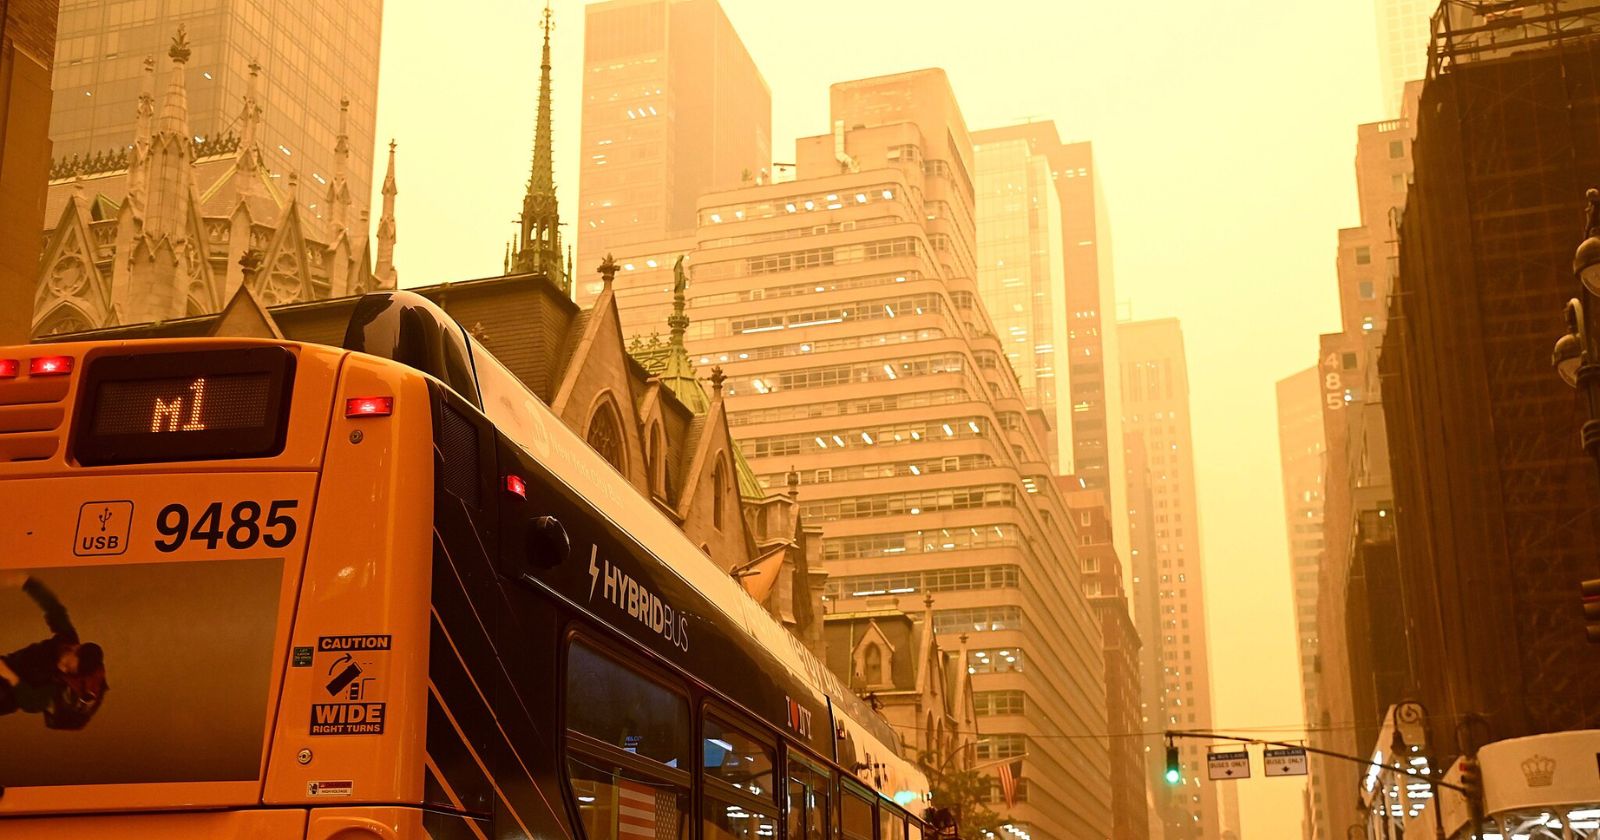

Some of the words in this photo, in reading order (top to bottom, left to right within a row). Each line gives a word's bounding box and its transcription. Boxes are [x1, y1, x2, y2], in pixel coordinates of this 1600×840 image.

[1324, 352, 1343, 410] 485
[154, 500, 298, 552] 9485
[82, 535, 119, 550] USB
[321, 637, 388, 649] CAUTION
[315, 704, 382, 724] WIDE
[312, 725, 344, 733] RIGHT
[346, 724, 381, 732] TURNS
